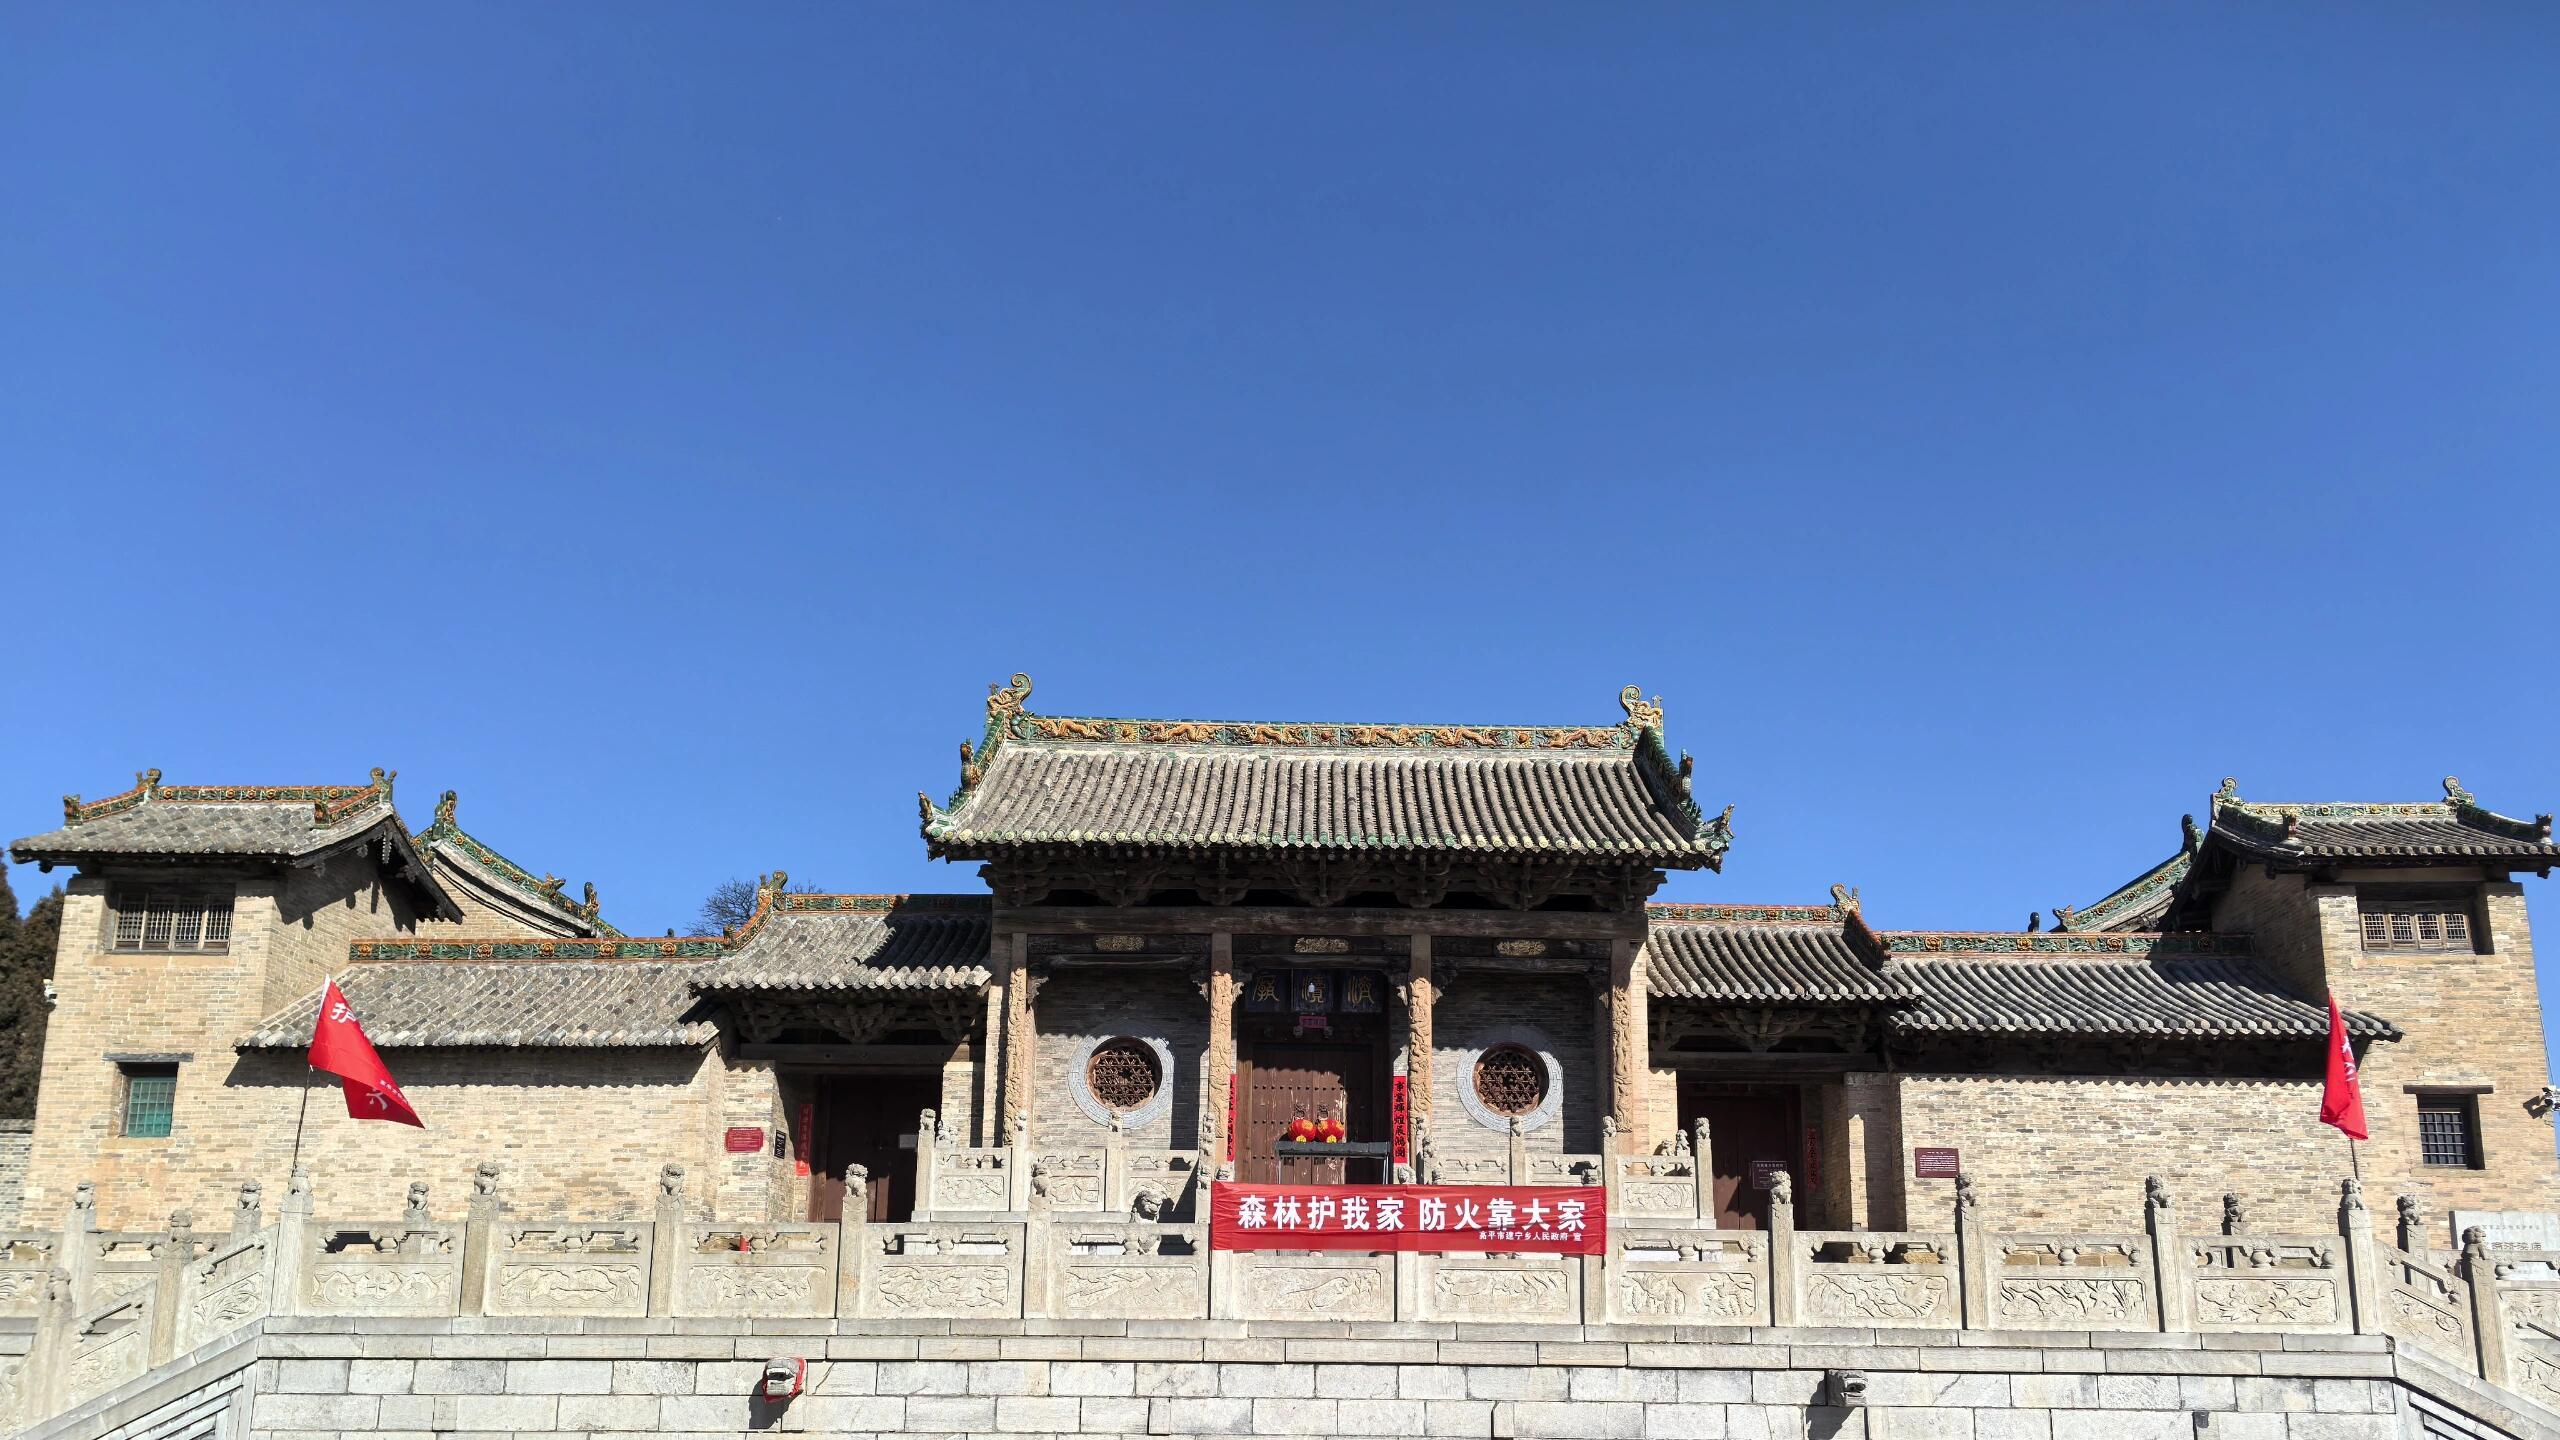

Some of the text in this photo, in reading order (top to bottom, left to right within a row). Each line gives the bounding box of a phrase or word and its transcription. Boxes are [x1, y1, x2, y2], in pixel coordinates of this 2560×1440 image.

[1237, 1194, 1586, 1232] 森林护我家 防火靠大家
[1479, 1230, 1582, 1242] 高平市建宁乡人民政府 宣
